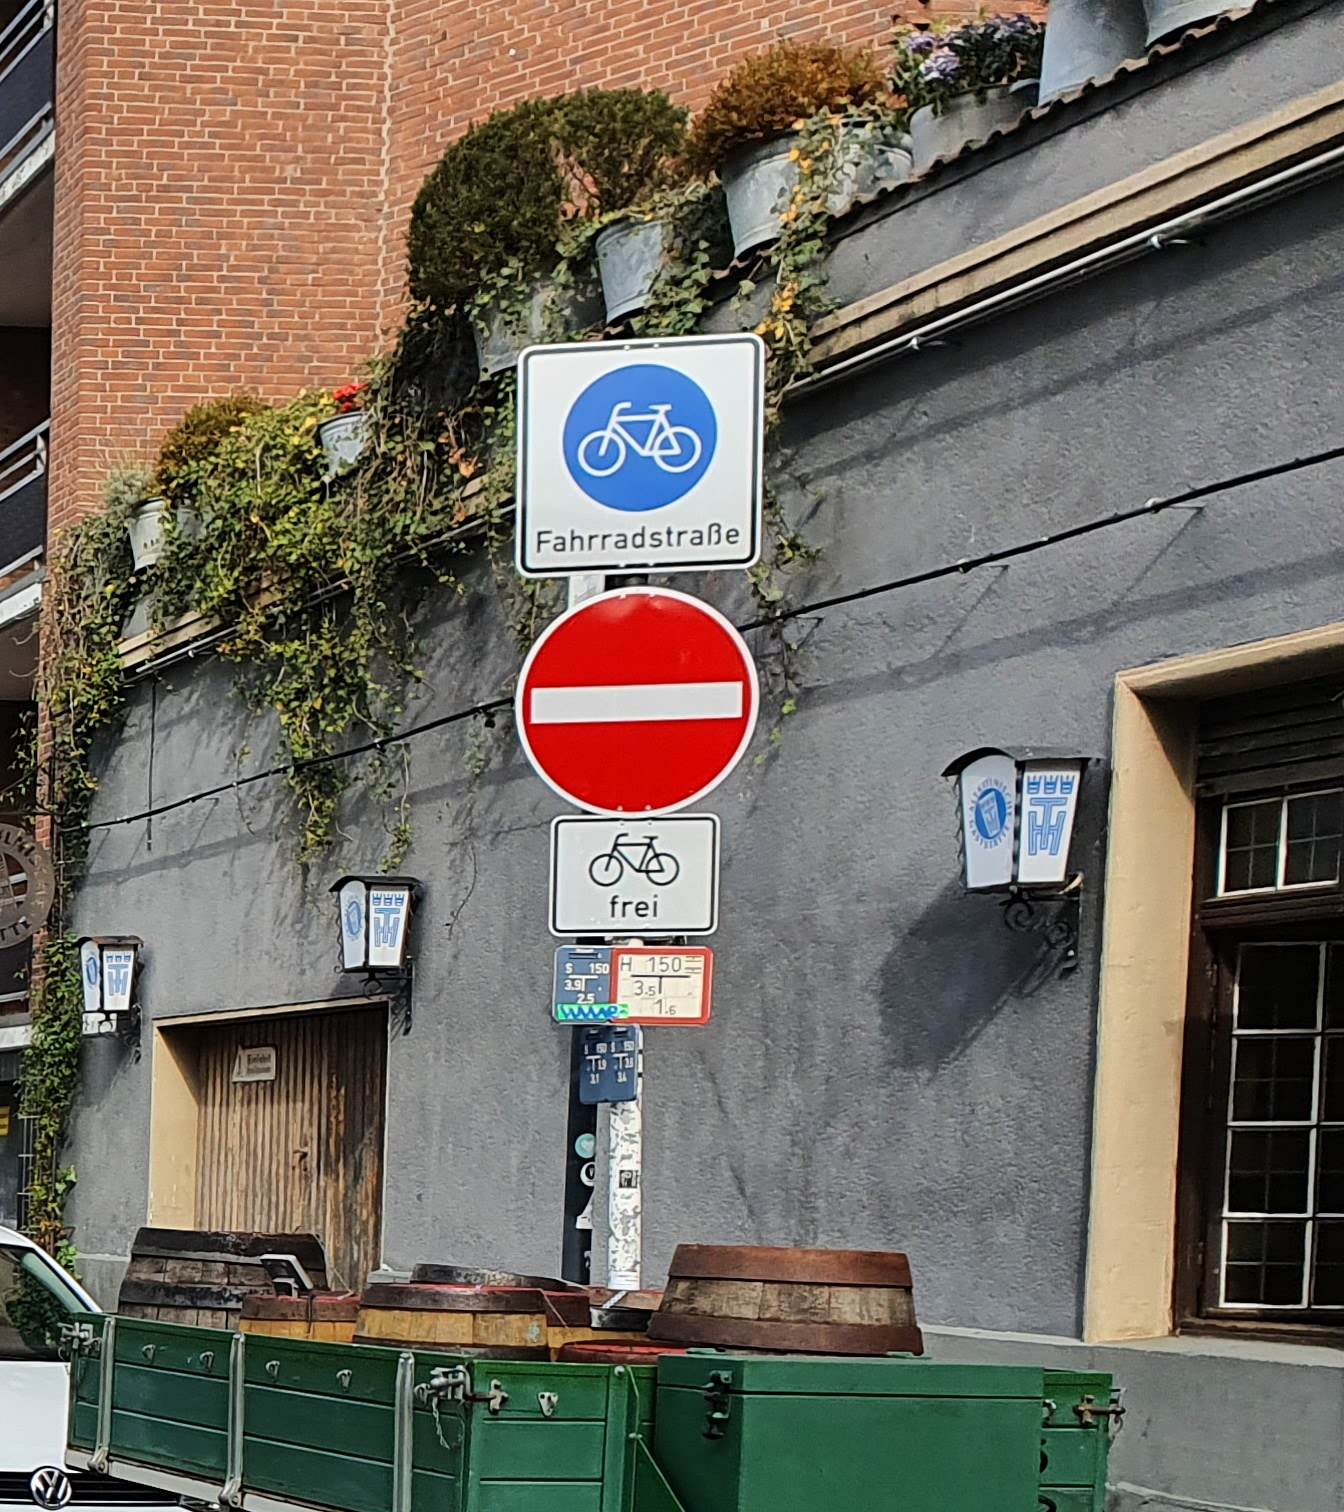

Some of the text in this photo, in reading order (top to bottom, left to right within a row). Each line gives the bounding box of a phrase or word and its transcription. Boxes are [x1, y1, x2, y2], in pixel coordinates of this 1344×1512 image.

[535, 522, 741, 555] Fahrradstraße
[608, 893, 659, 920] frei
[588, 962, 610, 974] 150
[620, 956, 682, 973] H 150
[634, 980, 656, 996] 3.5
[654, 999, 677, 1015] 1.6
